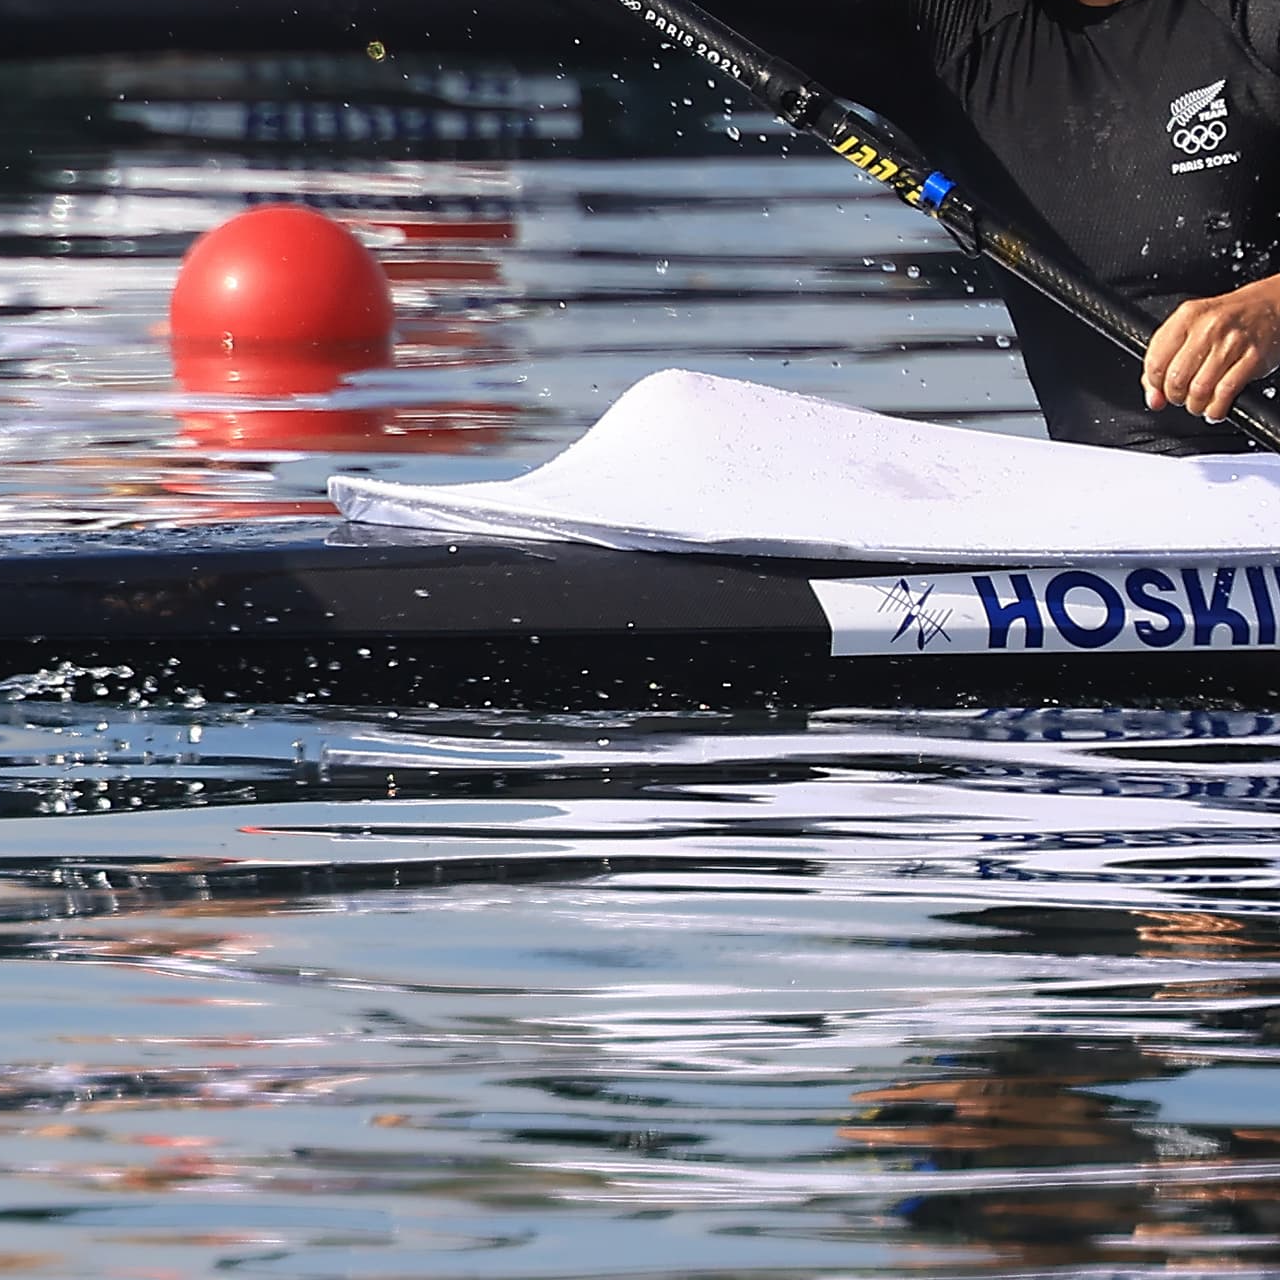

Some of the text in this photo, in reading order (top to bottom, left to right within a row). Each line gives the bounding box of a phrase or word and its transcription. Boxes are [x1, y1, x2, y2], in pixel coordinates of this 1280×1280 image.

[645, 10, 741, 78] PARIS 2024
[1198, 108, 1228, 122] TEAM
[1172, 151, 1240, 174] PARIS 2024
[972, 568, 1280, 649] HOSKI
